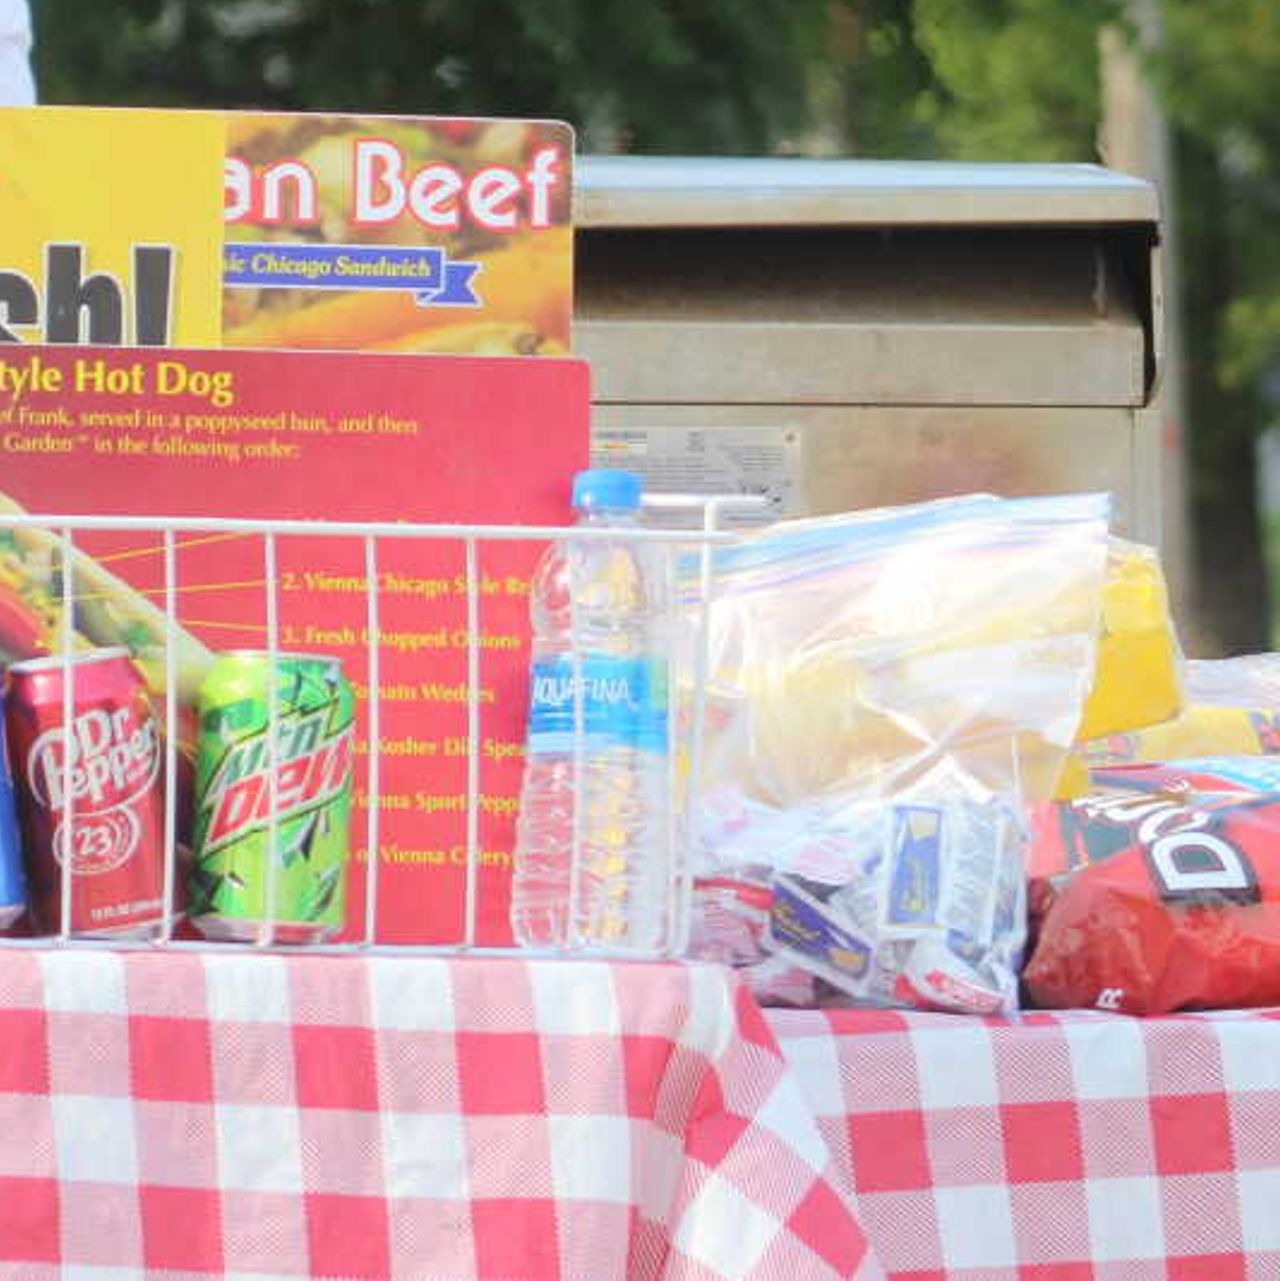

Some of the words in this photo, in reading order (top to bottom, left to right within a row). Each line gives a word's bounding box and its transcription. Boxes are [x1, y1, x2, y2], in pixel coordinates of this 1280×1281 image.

[352, 137, 560, 230] Beef
[250, 253, 331, 280] Chicago
[336, 256, 432, 278] Sandwich
[74, 359, 146, 394] Hot
[157, 361, 234, 407] Dog
[185, 412, 286, 435] poppyseed
[151, 435, 240, 462] following
[73, 707, 131, 754] Dr
[74, 827, 113, 857] 23
